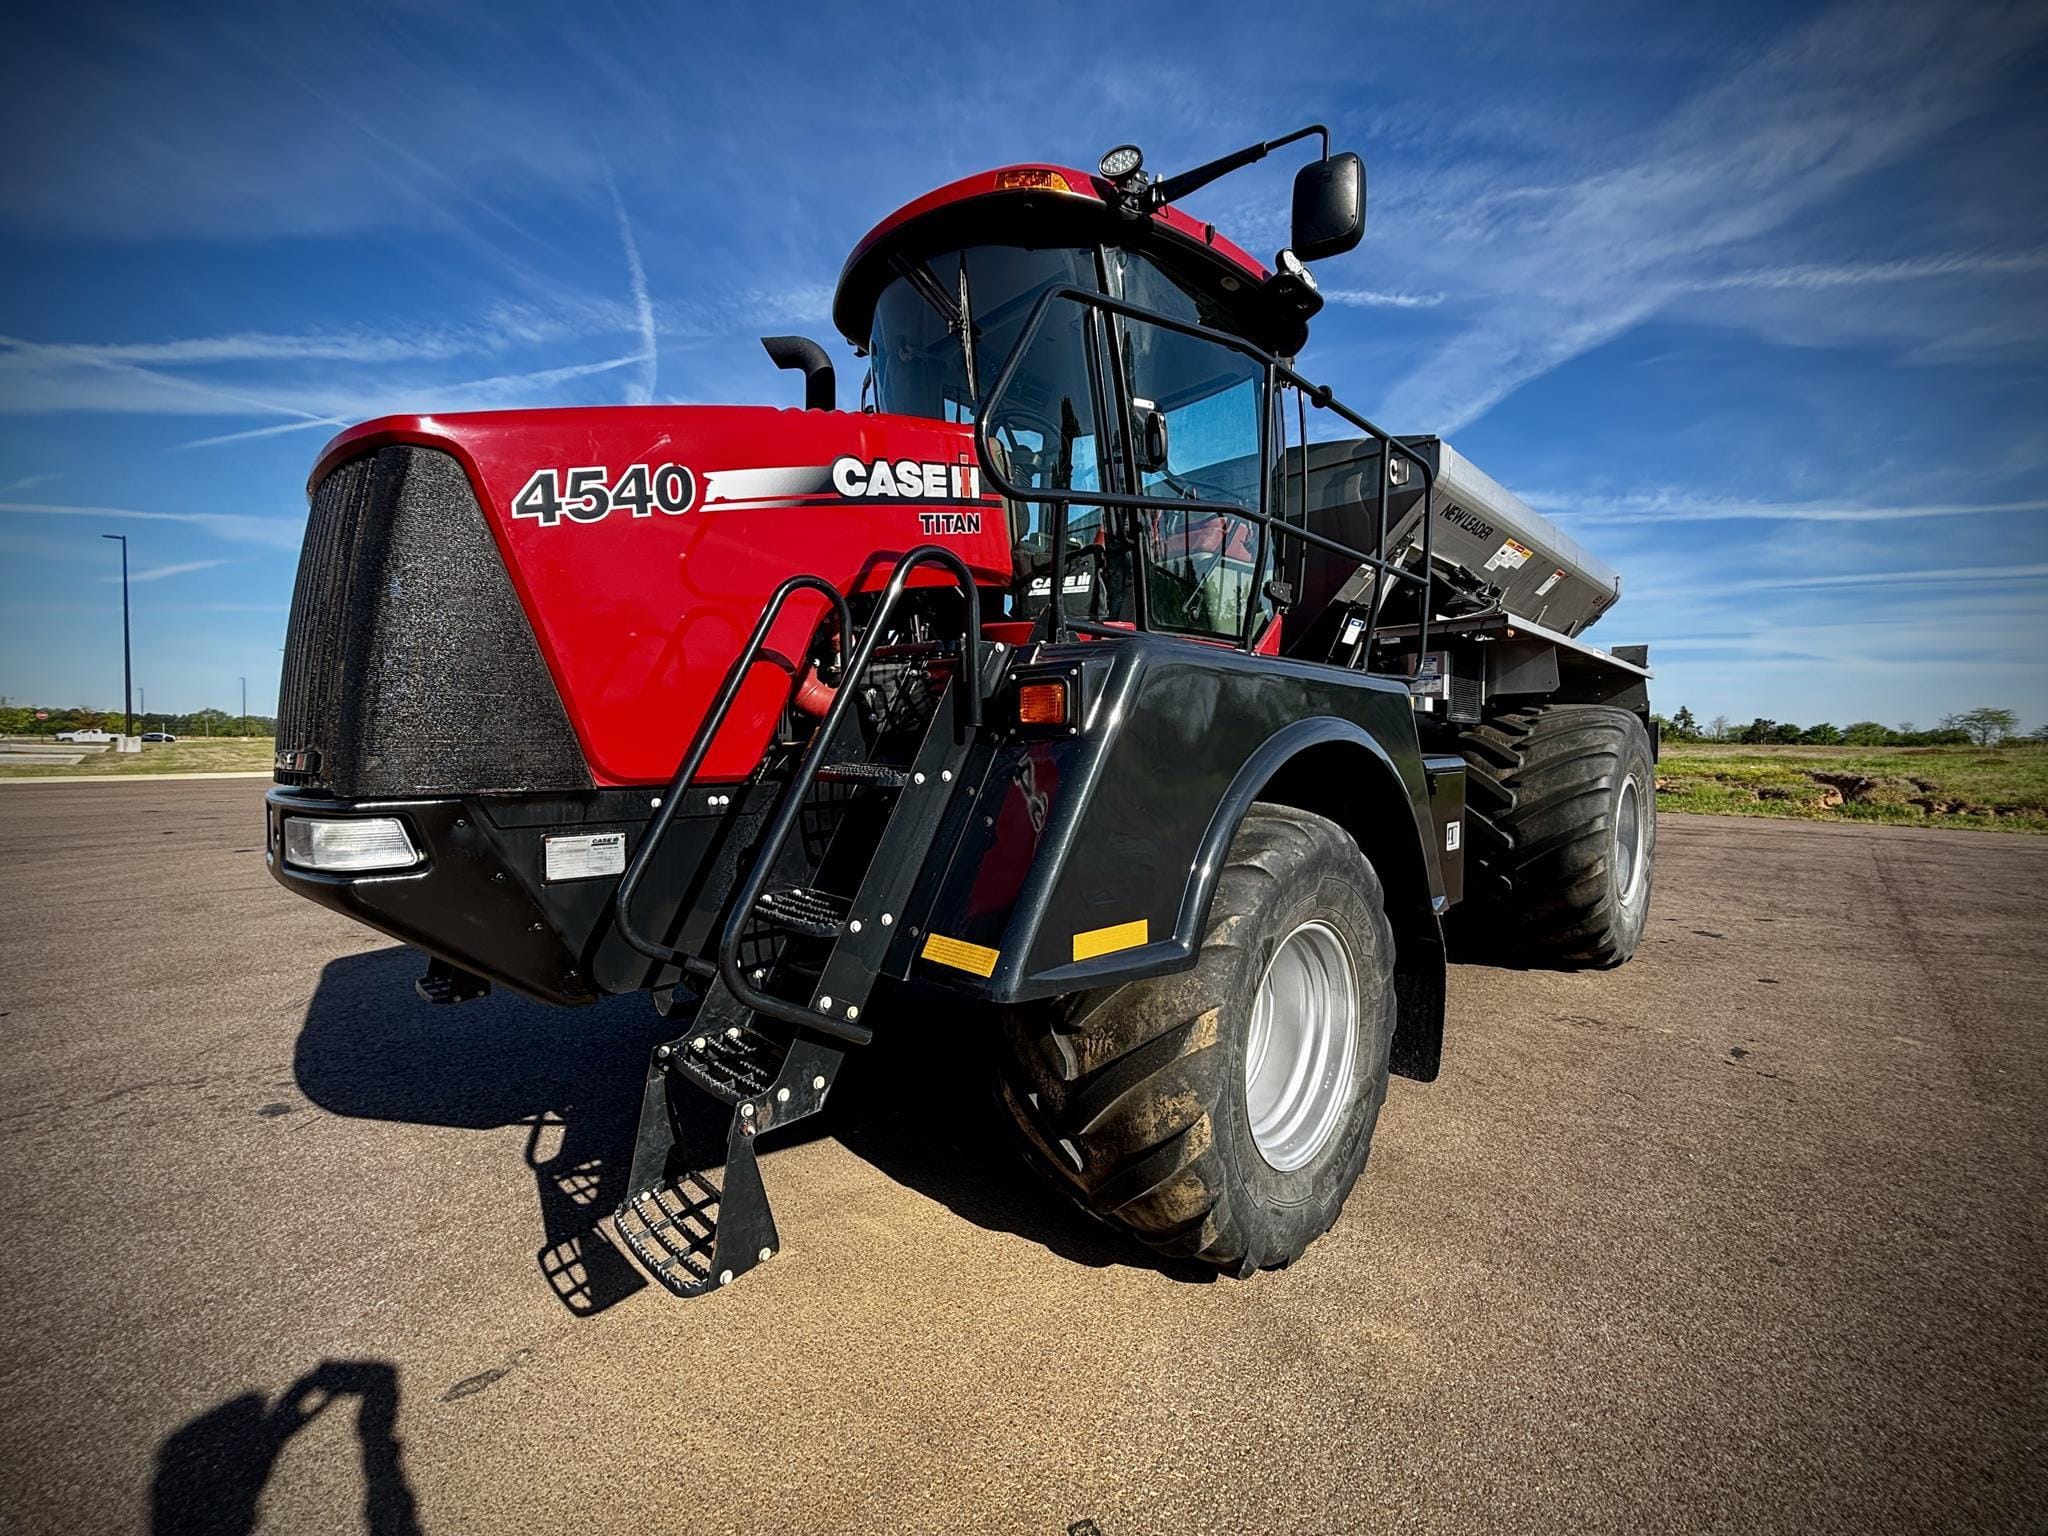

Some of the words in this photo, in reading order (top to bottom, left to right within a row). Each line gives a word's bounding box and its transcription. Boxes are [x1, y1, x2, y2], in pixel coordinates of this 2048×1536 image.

[512, 463, 696, 527] 4540
[832, 457, 948, 498] CASE
[919, 512, 981, 535] TITAN
[1440, 502, 1469, 525] NEW
[1460, 514, 1494, 541] LEADER
[1031, 576, 1076, 589] CAE
